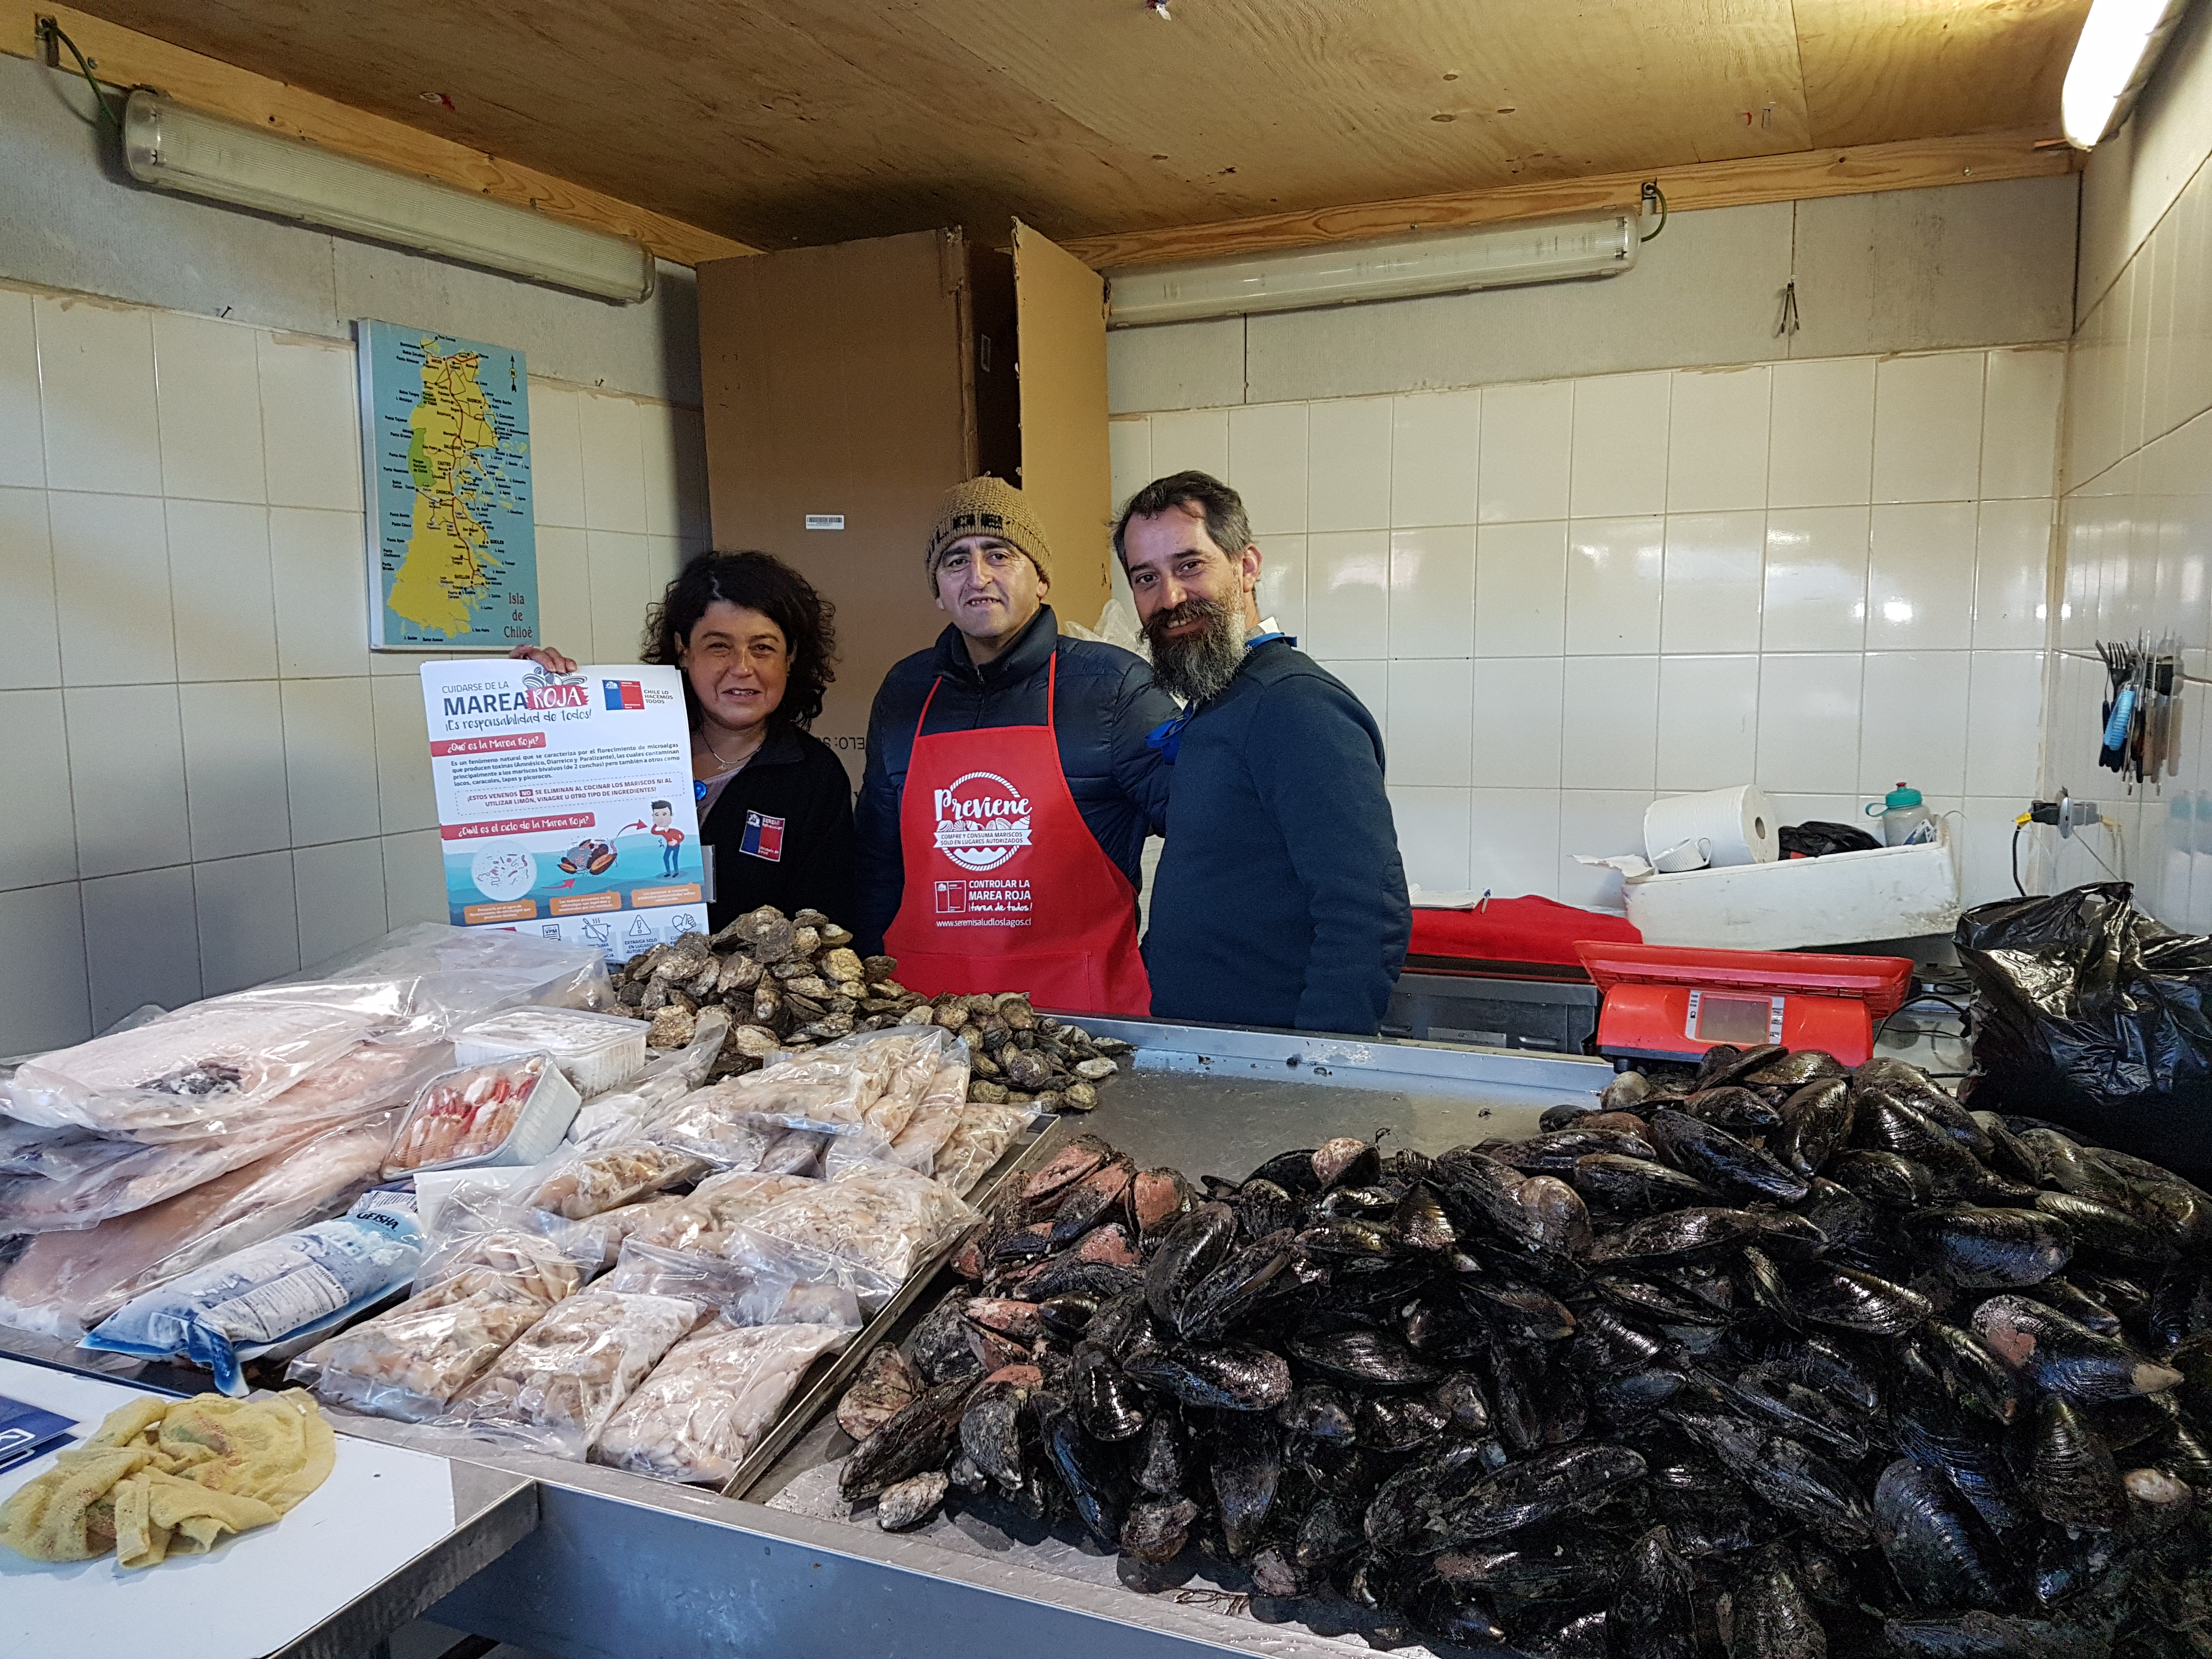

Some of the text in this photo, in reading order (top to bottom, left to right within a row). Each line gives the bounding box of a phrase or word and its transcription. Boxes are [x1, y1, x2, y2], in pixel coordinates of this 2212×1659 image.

[509, 592, 524, 605] Isla
[512, 610, 523, 621] de
[504, 626, 532, 638] Chiloé
[442, 683, 483, 693] CUIDARSE
[443, 687, 582, 716] MAREA ROJA
[445, 708, 592, 731] ¡Es responsabilidad de todos!
[447, 742, 466, 753] ¿Qué
[478, 740, 487, 749] la
[489, 740, 516, 748] Marea
[517, 736, 538, 748] Roja?
[579, 753, 616, 761] Paralizante),
[453, 771, 497, 780] principalmente
[611, 786, 656, 795] INGREDIENTES!
[934, 788, 1032, 821] Previene
[458, 825, 478, 837] ¿Cuál
[491, 823, 498, 832] el
[500, 822, 517, 831] ciclo
[520, 820, 529, 829] de
[532, 820, 540, 828] la
[569, 815, 589, 827] Roja?
[969, 880, 1017, 888] CONTROLAR
[969, 890, 1031, 900] MAREA ROJA
[968, 902, 1032, 912] ¡tarea de todos!
[936, 918, 1031, 928] www.seremisaludloslagos.cl
[357, 1211, 399, 1229] GEISHA
[315, 1265, 337, 1286] Nutrition
